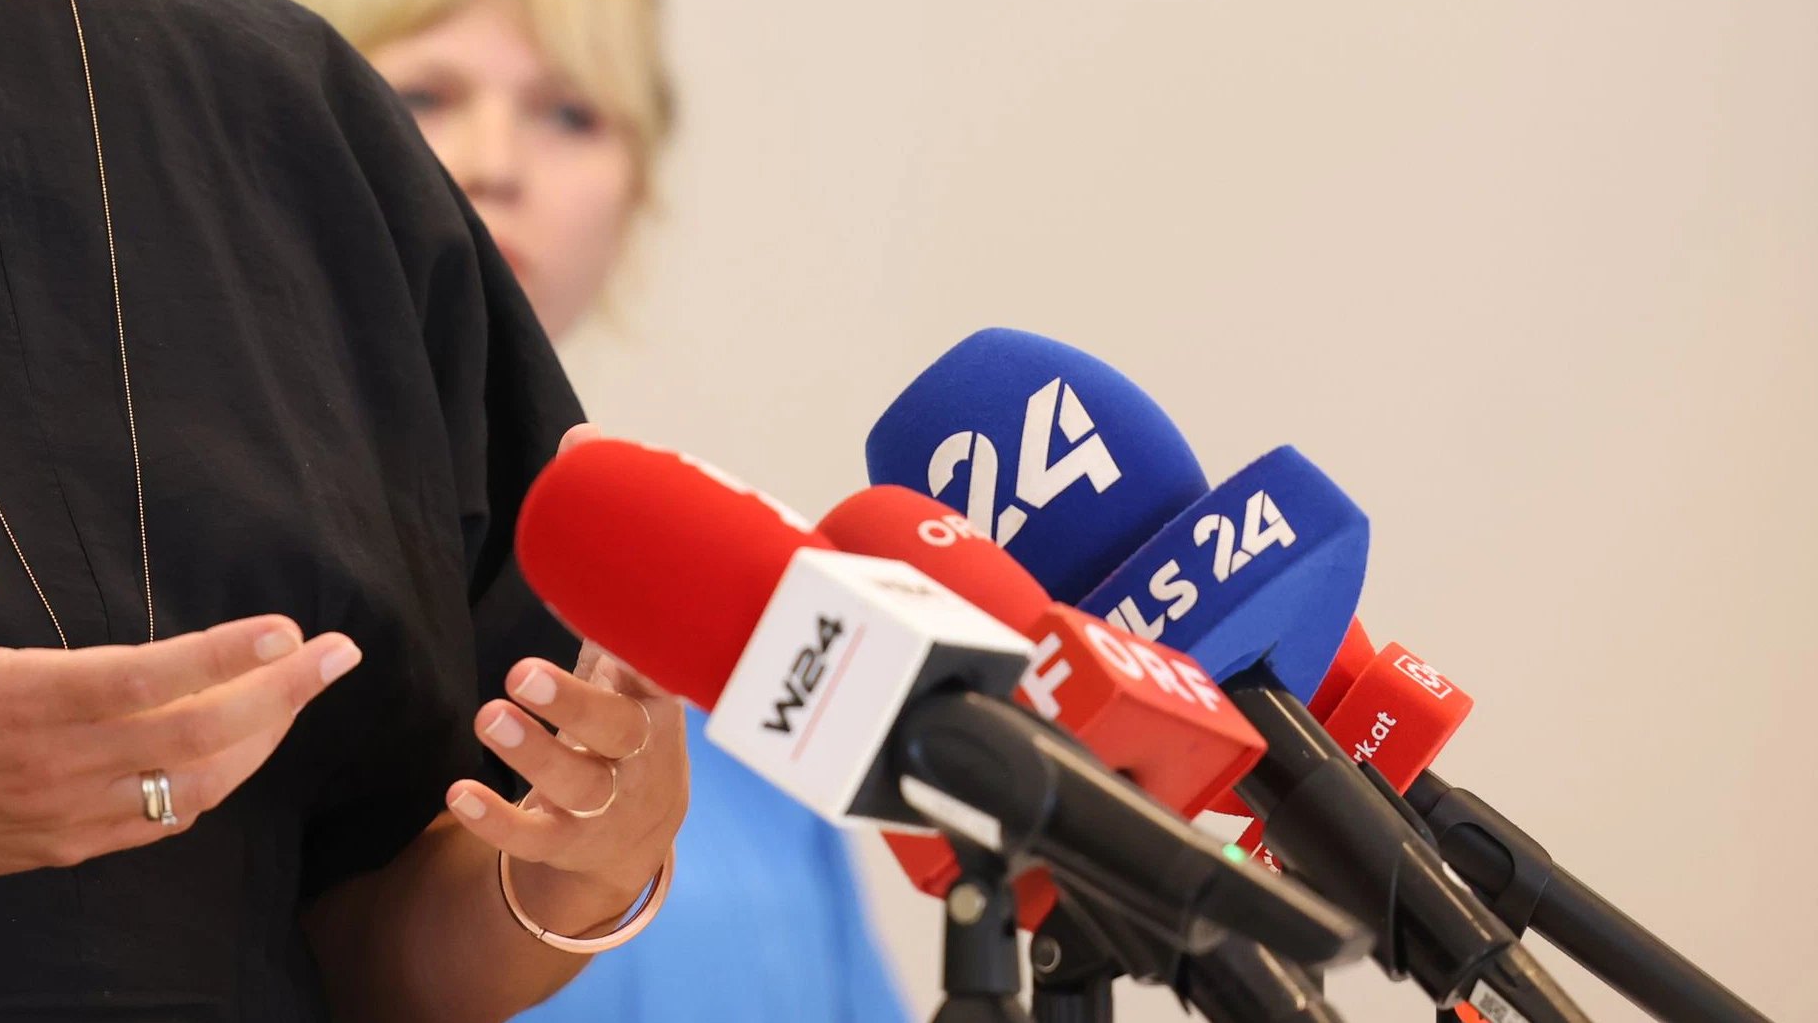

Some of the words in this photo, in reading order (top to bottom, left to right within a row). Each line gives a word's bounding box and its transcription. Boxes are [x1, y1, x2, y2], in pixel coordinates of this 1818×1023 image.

[927, 376, 1123, 549] 24
[1192, 489, 1298, 584] 24
[760, 612, 845, 735] W24
[1084, 622, 1221, 713] ORF
